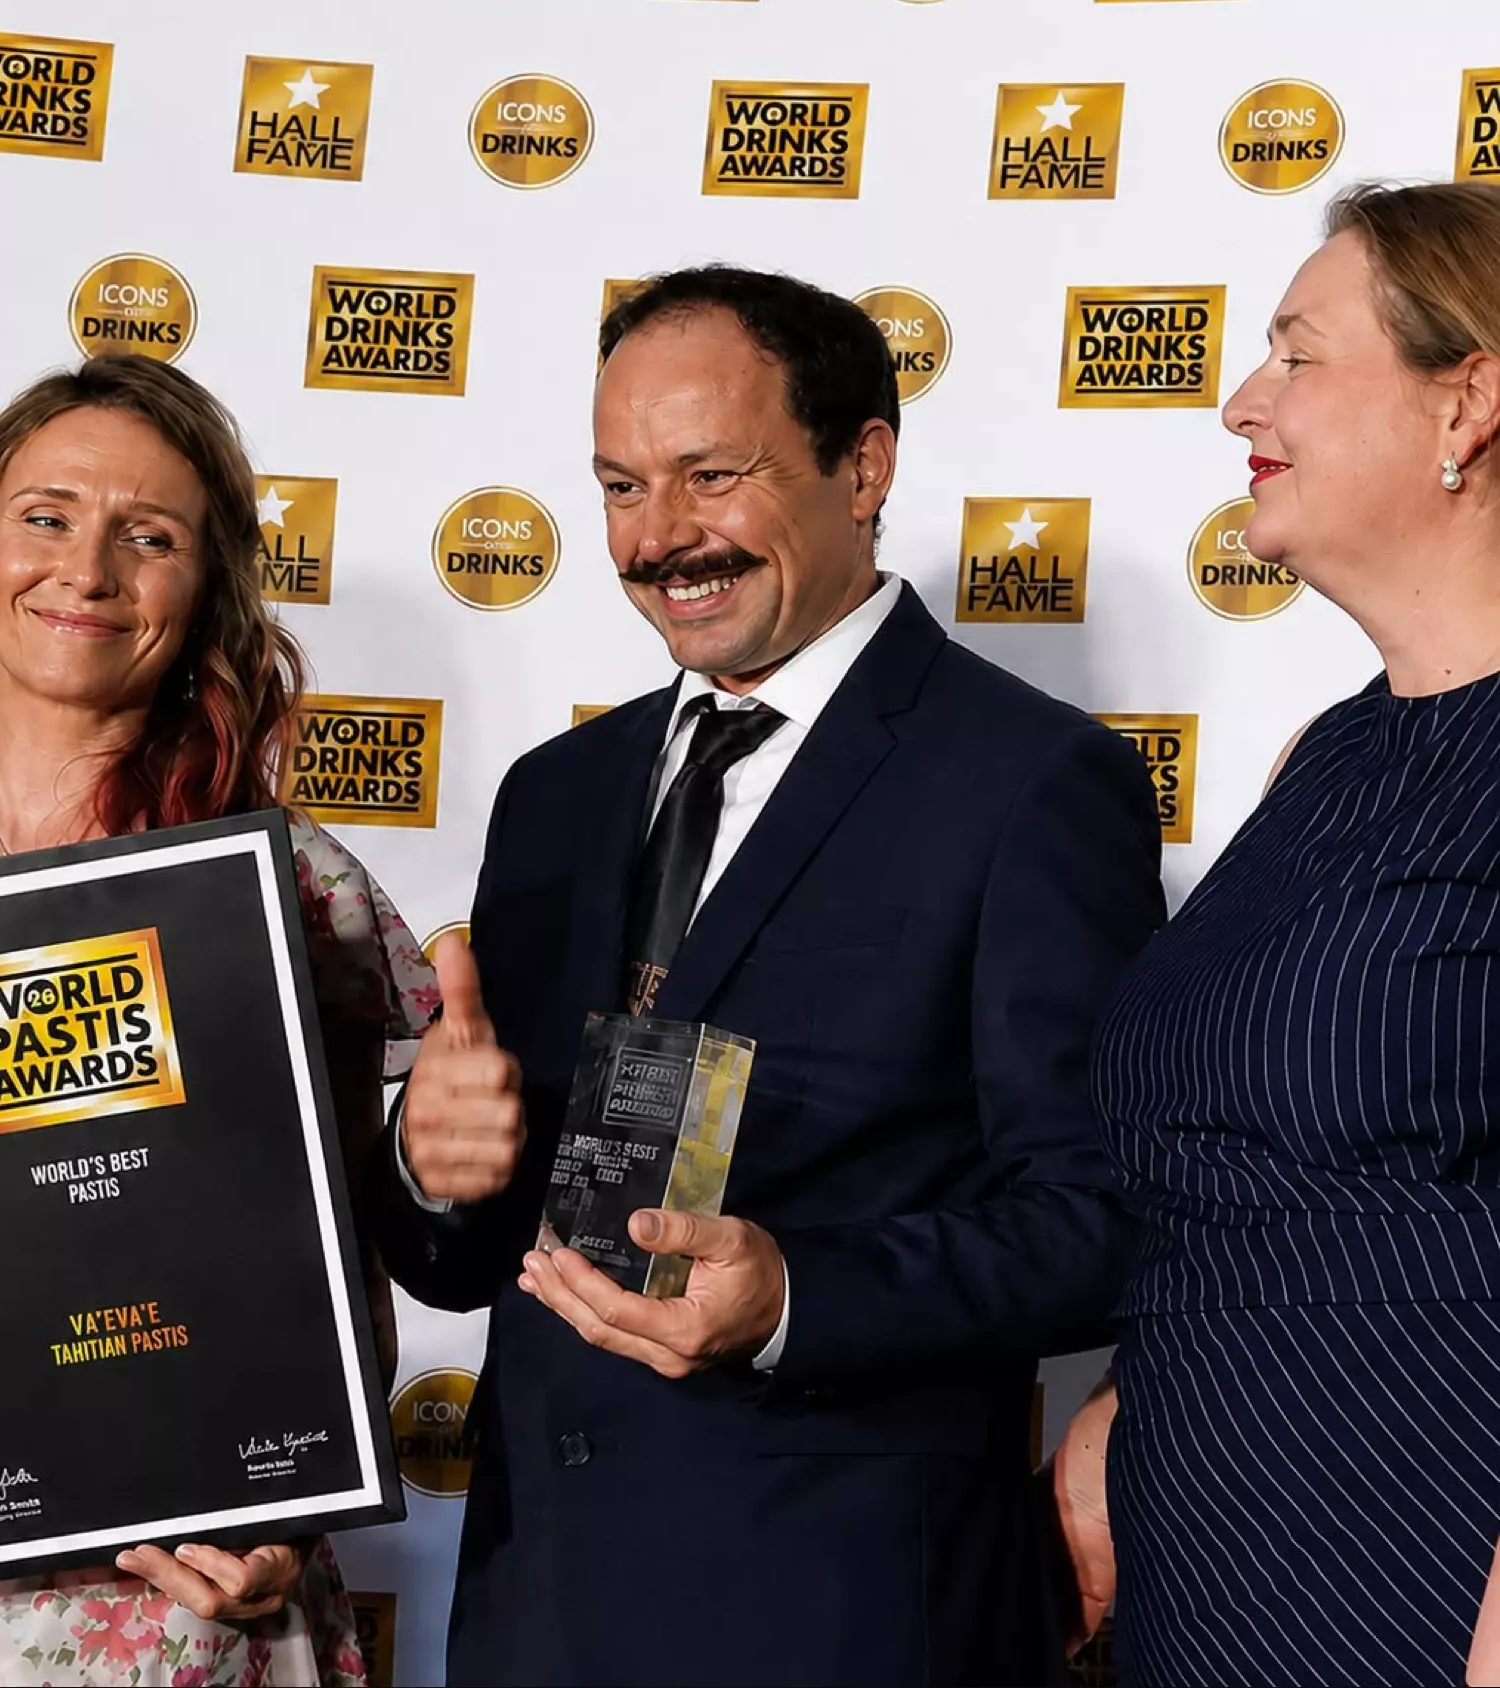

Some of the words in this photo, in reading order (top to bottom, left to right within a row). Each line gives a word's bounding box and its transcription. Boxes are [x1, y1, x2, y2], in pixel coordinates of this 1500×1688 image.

[497, 102, 566, 124] ICONS
[726, 101, 851, 127] WORLD
[1247, 109, 1316, 130] ICONS
[249, 111, 354, 143] HALL
[246, 138, 353, 170] FAME
[481, 133, 578, 158] DRINKS
[721, 128, 849, 154] DRINKS
[1002, 136, 1106, 163] HALL
[1231, 139, 1329, 163] DRINKS
[720, 155, 845, 178] AWARDS
[1000, 163, 1105, 189] FAME
[98, 284, 168, 308] ICONS
[327, 287, 456, 319] WORLD
[82, 317, 181, 344] DRINKS
[324, 316, 453, 349] DRINKS
[1081, 306, 1209, 334] WORLD
[323, 344, 450, 373] AWARDS
[1078, 334, 1206, 361] DRINKS
[1076, 362, 1204, 387] AWARDS
[461, 518, 533, 541] ICONS
[257, 531, 320, 562] ALL
[261, 562, 320, 593] ME
[447, 552, 544, 576] DRINKS
[969, 556, 1073, 584] HALL
[967, 585, 1073, 612] FAME
[299, 716, 425, 748] WORLD
[292, 746, 423, 778] DRINKS
[291, 775, 421, 805] AWARDS
[31, 1155, 105, 1187] WORLD'S
[110, 1147, 150, 1171] BEST
[68, 1177, 120, 1204] PASTIS
[50, 1331, 128, 1367] TAHITIAN
[131, 1324, 189, 1354] PASTIS
[413, 1401, 469, 1423] ICON
